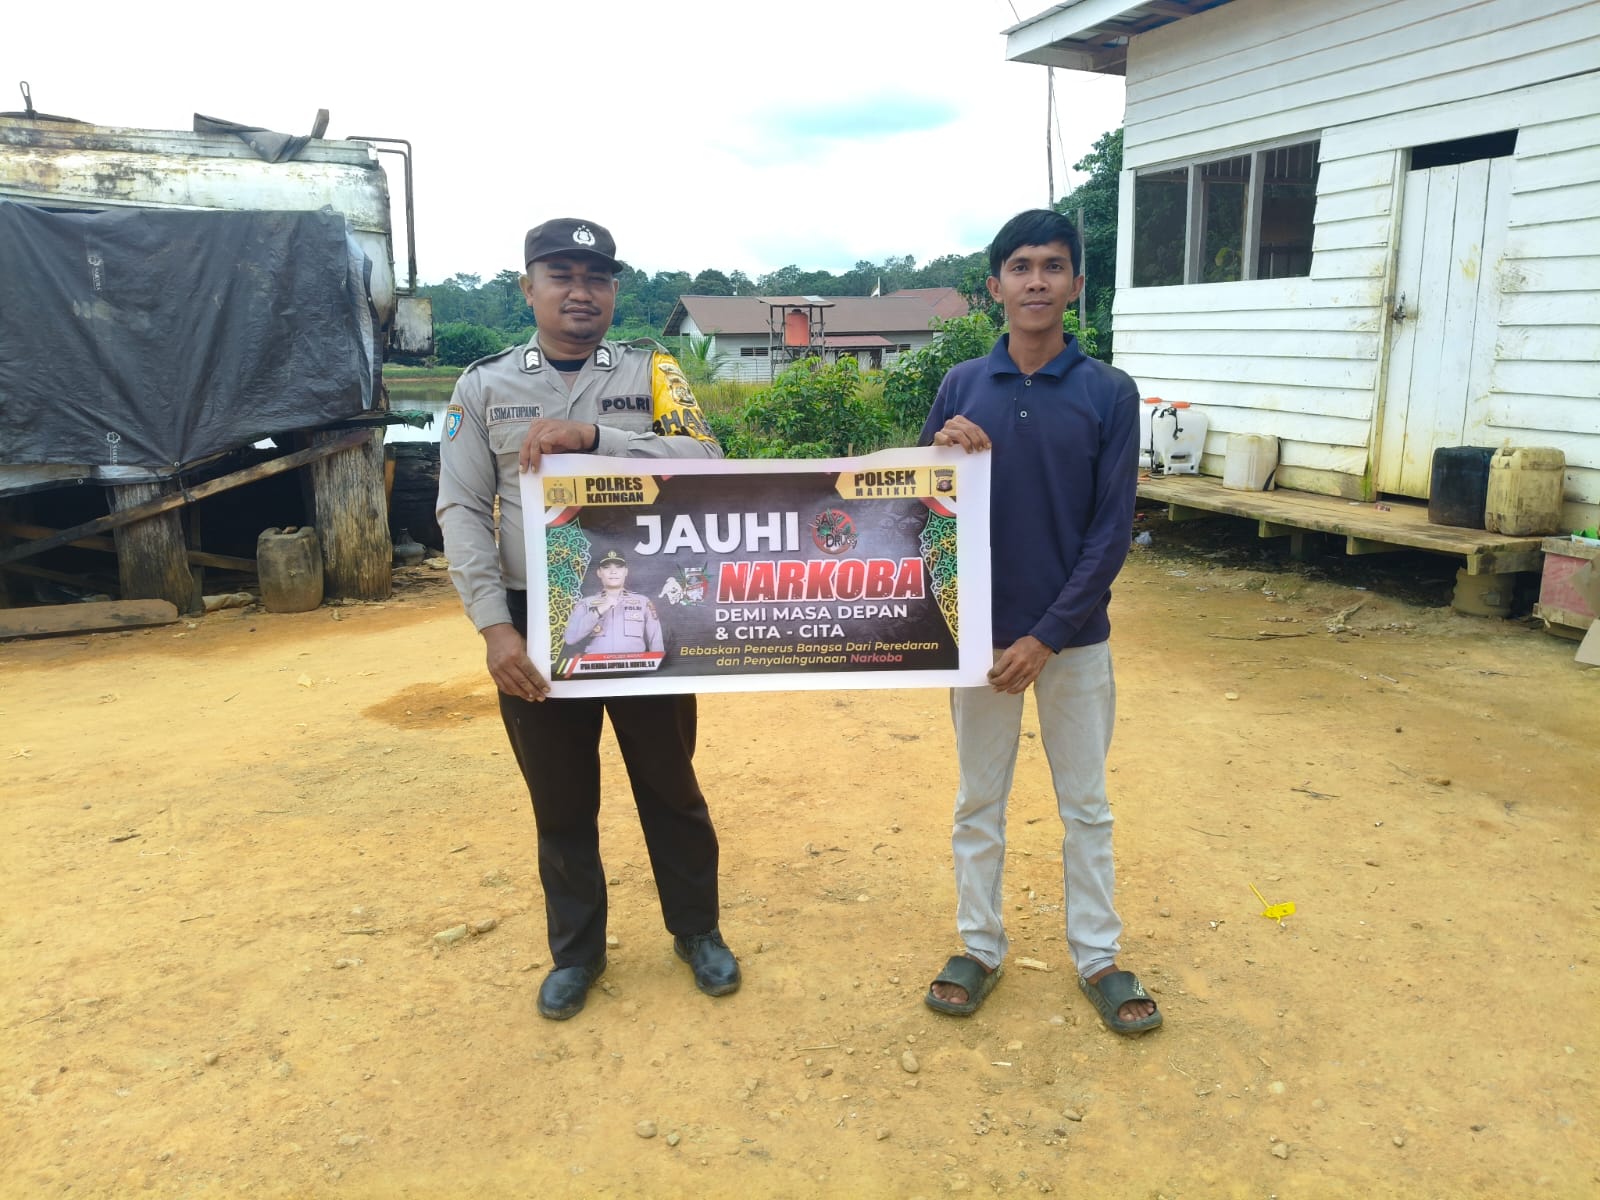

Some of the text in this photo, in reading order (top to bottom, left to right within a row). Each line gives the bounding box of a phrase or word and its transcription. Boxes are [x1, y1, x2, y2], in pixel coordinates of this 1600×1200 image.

[601, 396, 650, 411] POLRI
[585, 477, 643, 492] POLRES
[854, 470, 916, 487] POLSEK
[586, 492, 644, 504] KATINGAN
[855, 486, 916, 497] MARIKIT
[634, 511, 799, 555] JAUHI
[716, 557, 926, 604] NARKOBA
[715, 604, 908, 622] DEMI MASA DEPAN
[715, 626, 729, 640] &
[735, 625, 781, 640] CITA
[799, 623, 846, 638] CITA
[680, 640, 939, 656] Bebaskan Penerus Bangsa Dari Peredaran
[716, 653, 903, 668] dan Penyalahgunaan Narkoba
